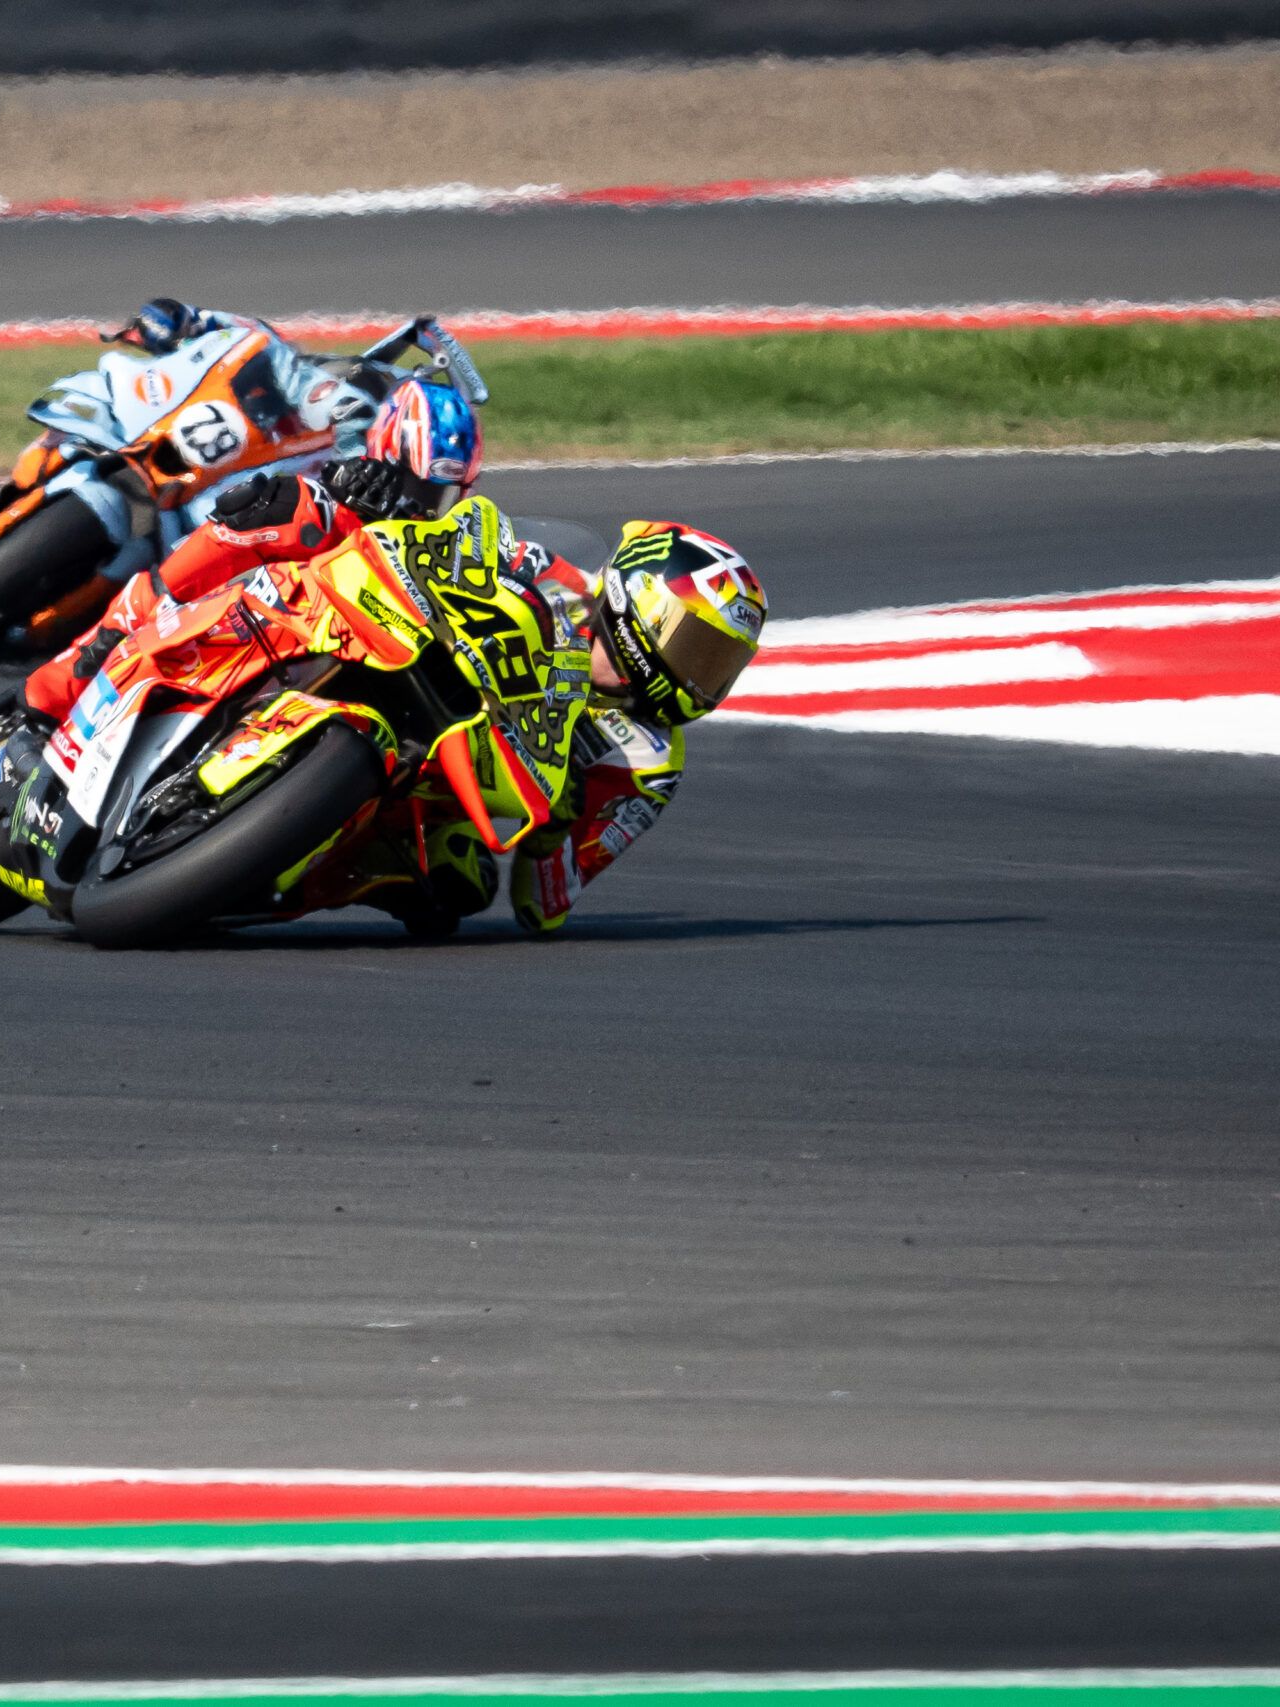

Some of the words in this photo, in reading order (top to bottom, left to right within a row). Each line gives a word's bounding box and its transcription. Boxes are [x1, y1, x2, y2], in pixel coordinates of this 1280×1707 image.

[389, 551, 431, 620] PERTAMINA
[436, 594, 542, 699] 49
[456, 638, 492, 690] HERO
[616, 616, 651, 678] MONSTER
